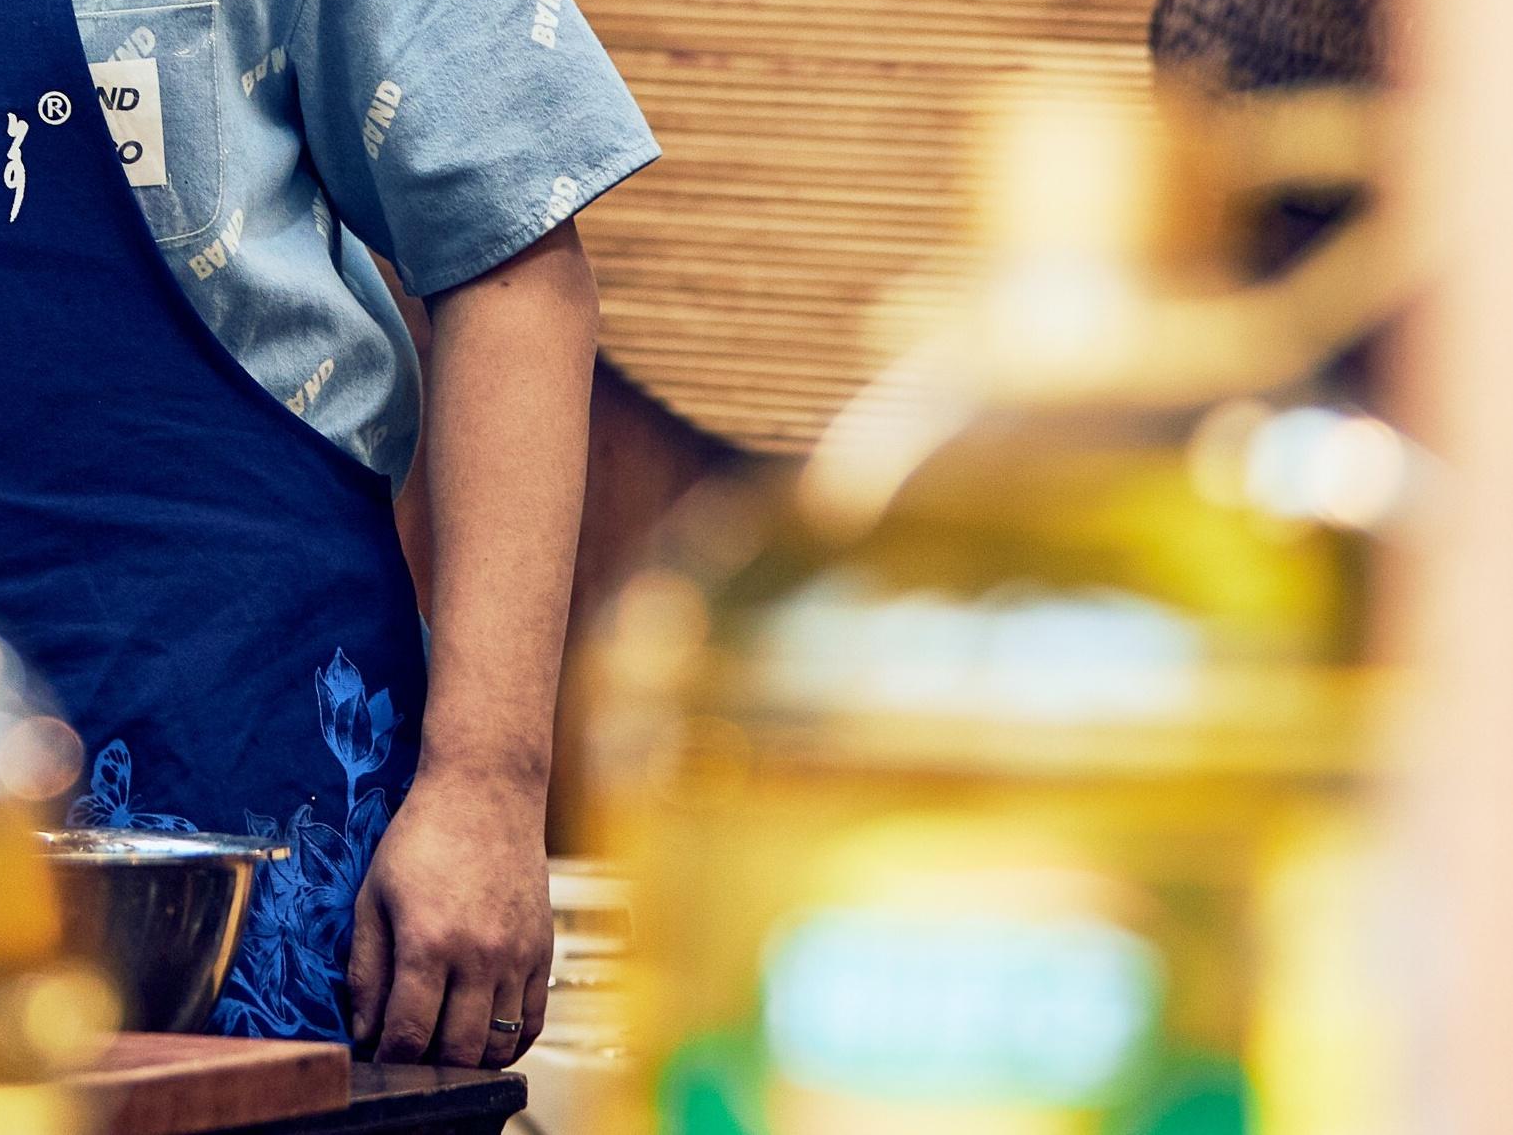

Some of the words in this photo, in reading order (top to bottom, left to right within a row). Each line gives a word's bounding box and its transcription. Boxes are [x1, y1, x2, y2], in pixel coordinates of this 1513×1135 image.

[96, 86, 140, 111] ND
[113, 140, 143, 165] O
[285, 358, 334, 416] AND
